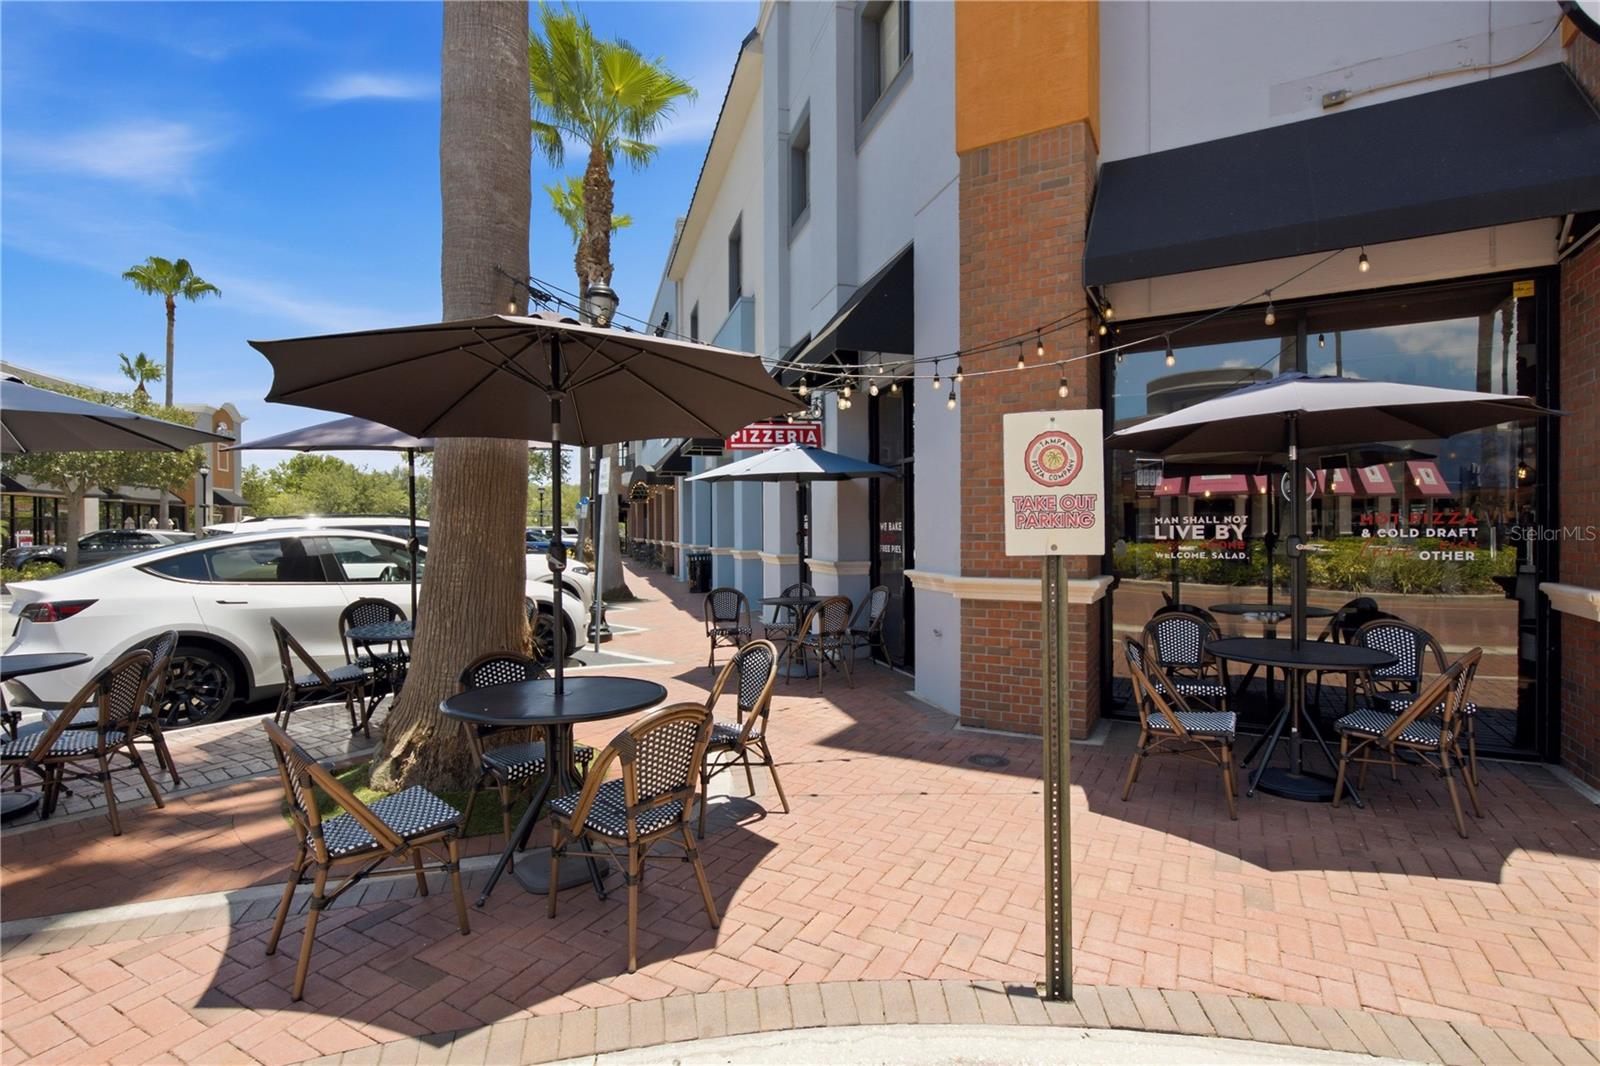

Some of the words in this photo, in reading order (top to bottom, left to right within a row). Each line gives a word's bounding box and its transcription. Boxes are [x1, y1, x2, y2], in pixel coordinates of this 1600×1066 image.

[730, 430, 817, 443] PIZZERIA
[1039, 438, 1066, 447] TAMPA
[1032, 460, 1045, 478] PIZZA
[1048, 459, 1075, 481] COMPANY
[1012, 495, 1057, 513] TAKE
[1060, 494, 1097, 512] OUT
[1015, 510, 1096, 529] PARKING
[1154, 516, 1179, 524] MAN
[1183, 515, 1220, 524] SHALL
[1224, 515, 1249, 524] NOT
[1409, 511, 1477, 525] PIZZA
[889, 522, 902, 531] BAKE
[1154, 524, 1205, 540] LIVE
[1215, 524, 1247, 541] BY
[1361, 528, 1371, 538] &
[1377, 528, 1420, 538] COLD
[1426, 527, 1479, 537] DRAFT
[1211, 552, 1250, 560] SALAD.
